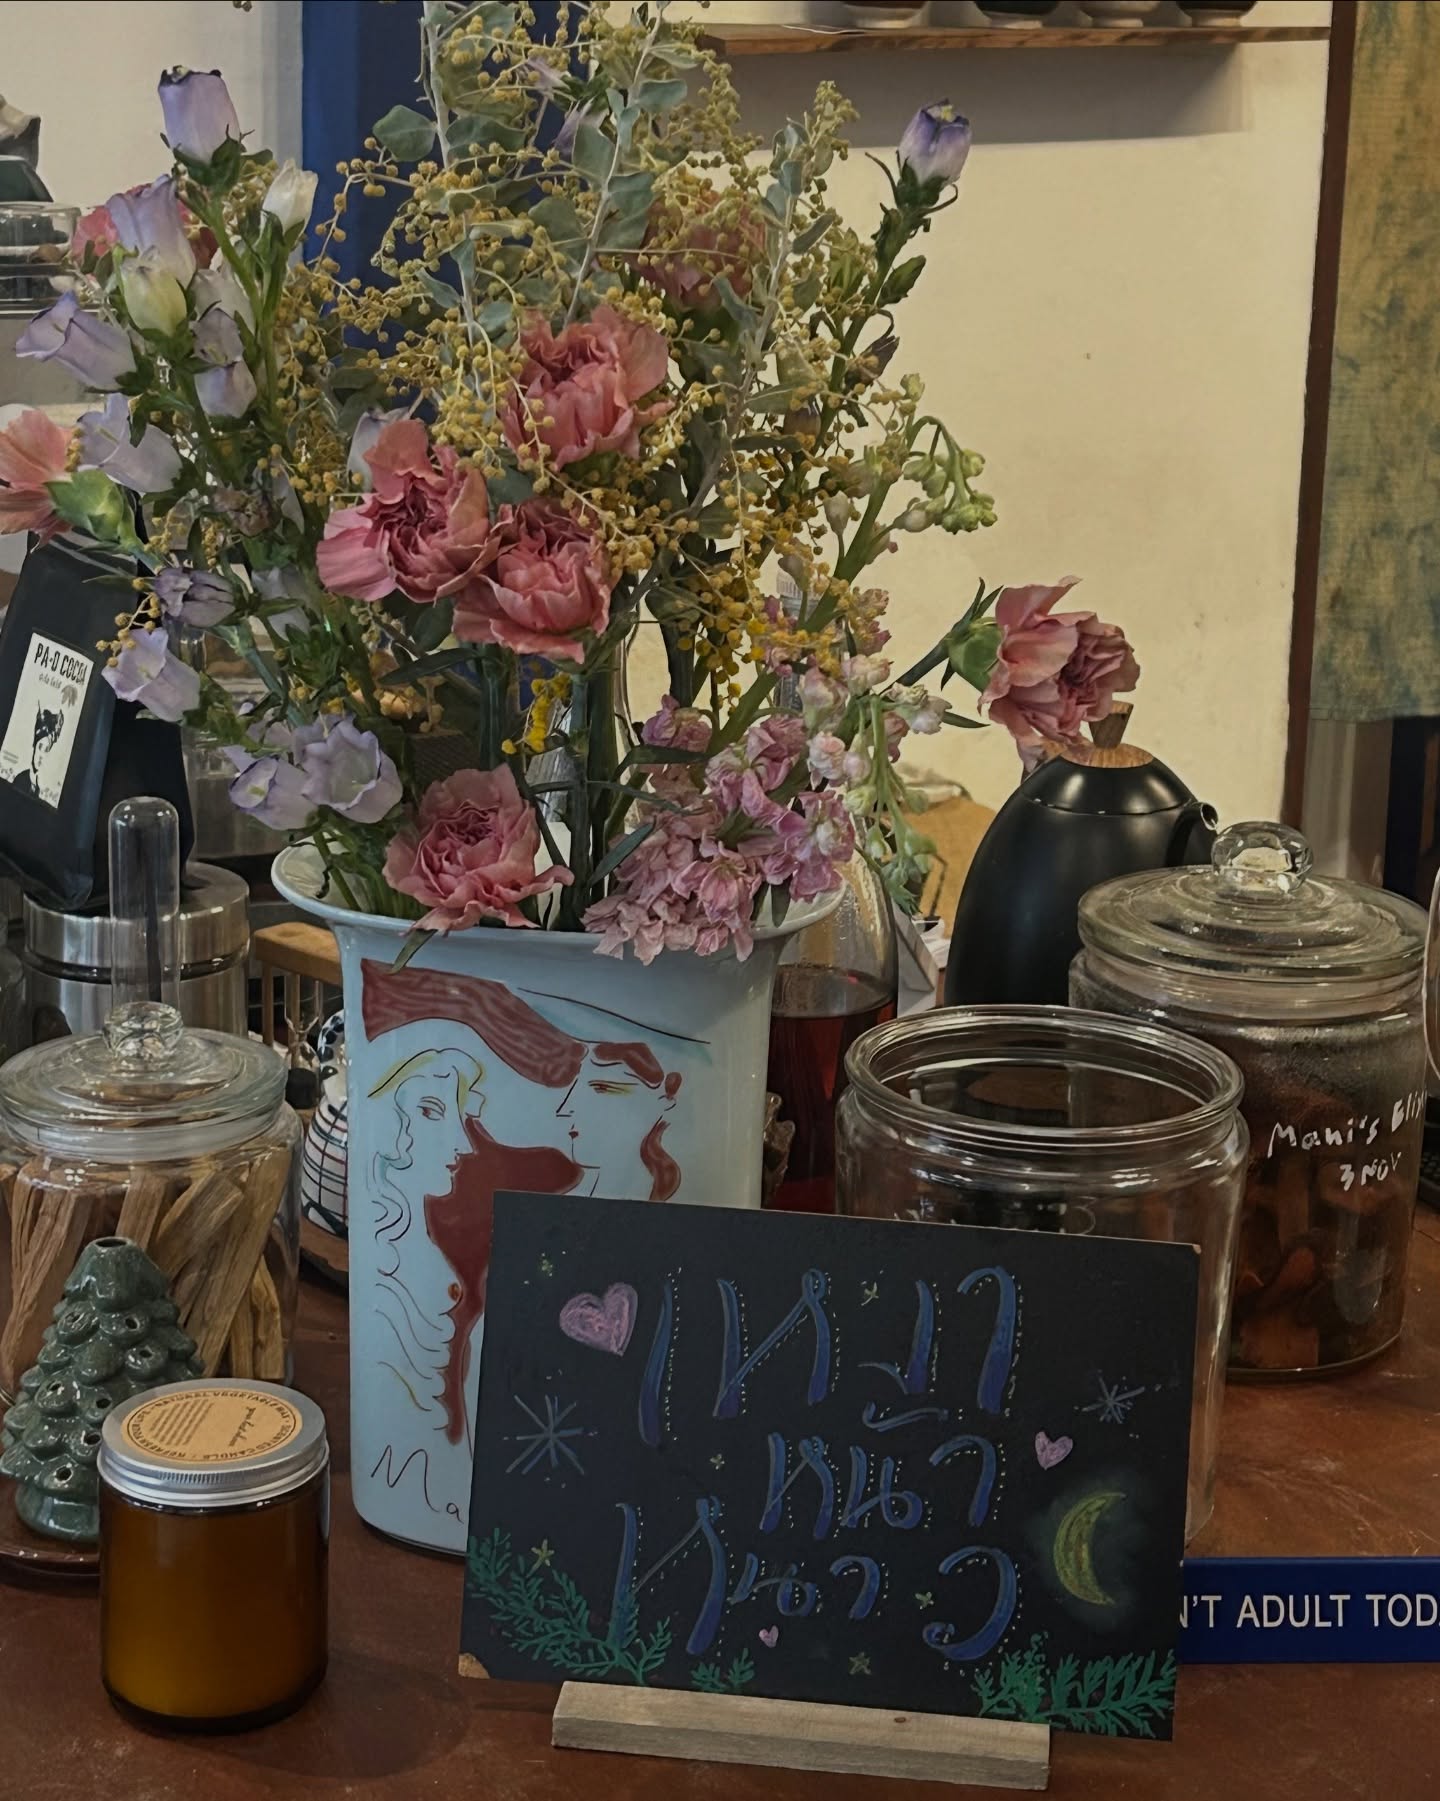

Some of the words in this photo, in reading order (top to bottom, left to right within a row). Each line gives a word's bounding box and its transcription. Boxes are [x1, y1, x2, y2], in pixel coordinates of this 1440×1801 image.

[1267, 1115, 1380, 1159] Mani's
[1339, 1163, 1355, 1191] 3
[1236, 1594, 1351, 1628] ADULT
[1365, 1593, 1440, 1628] TOD
